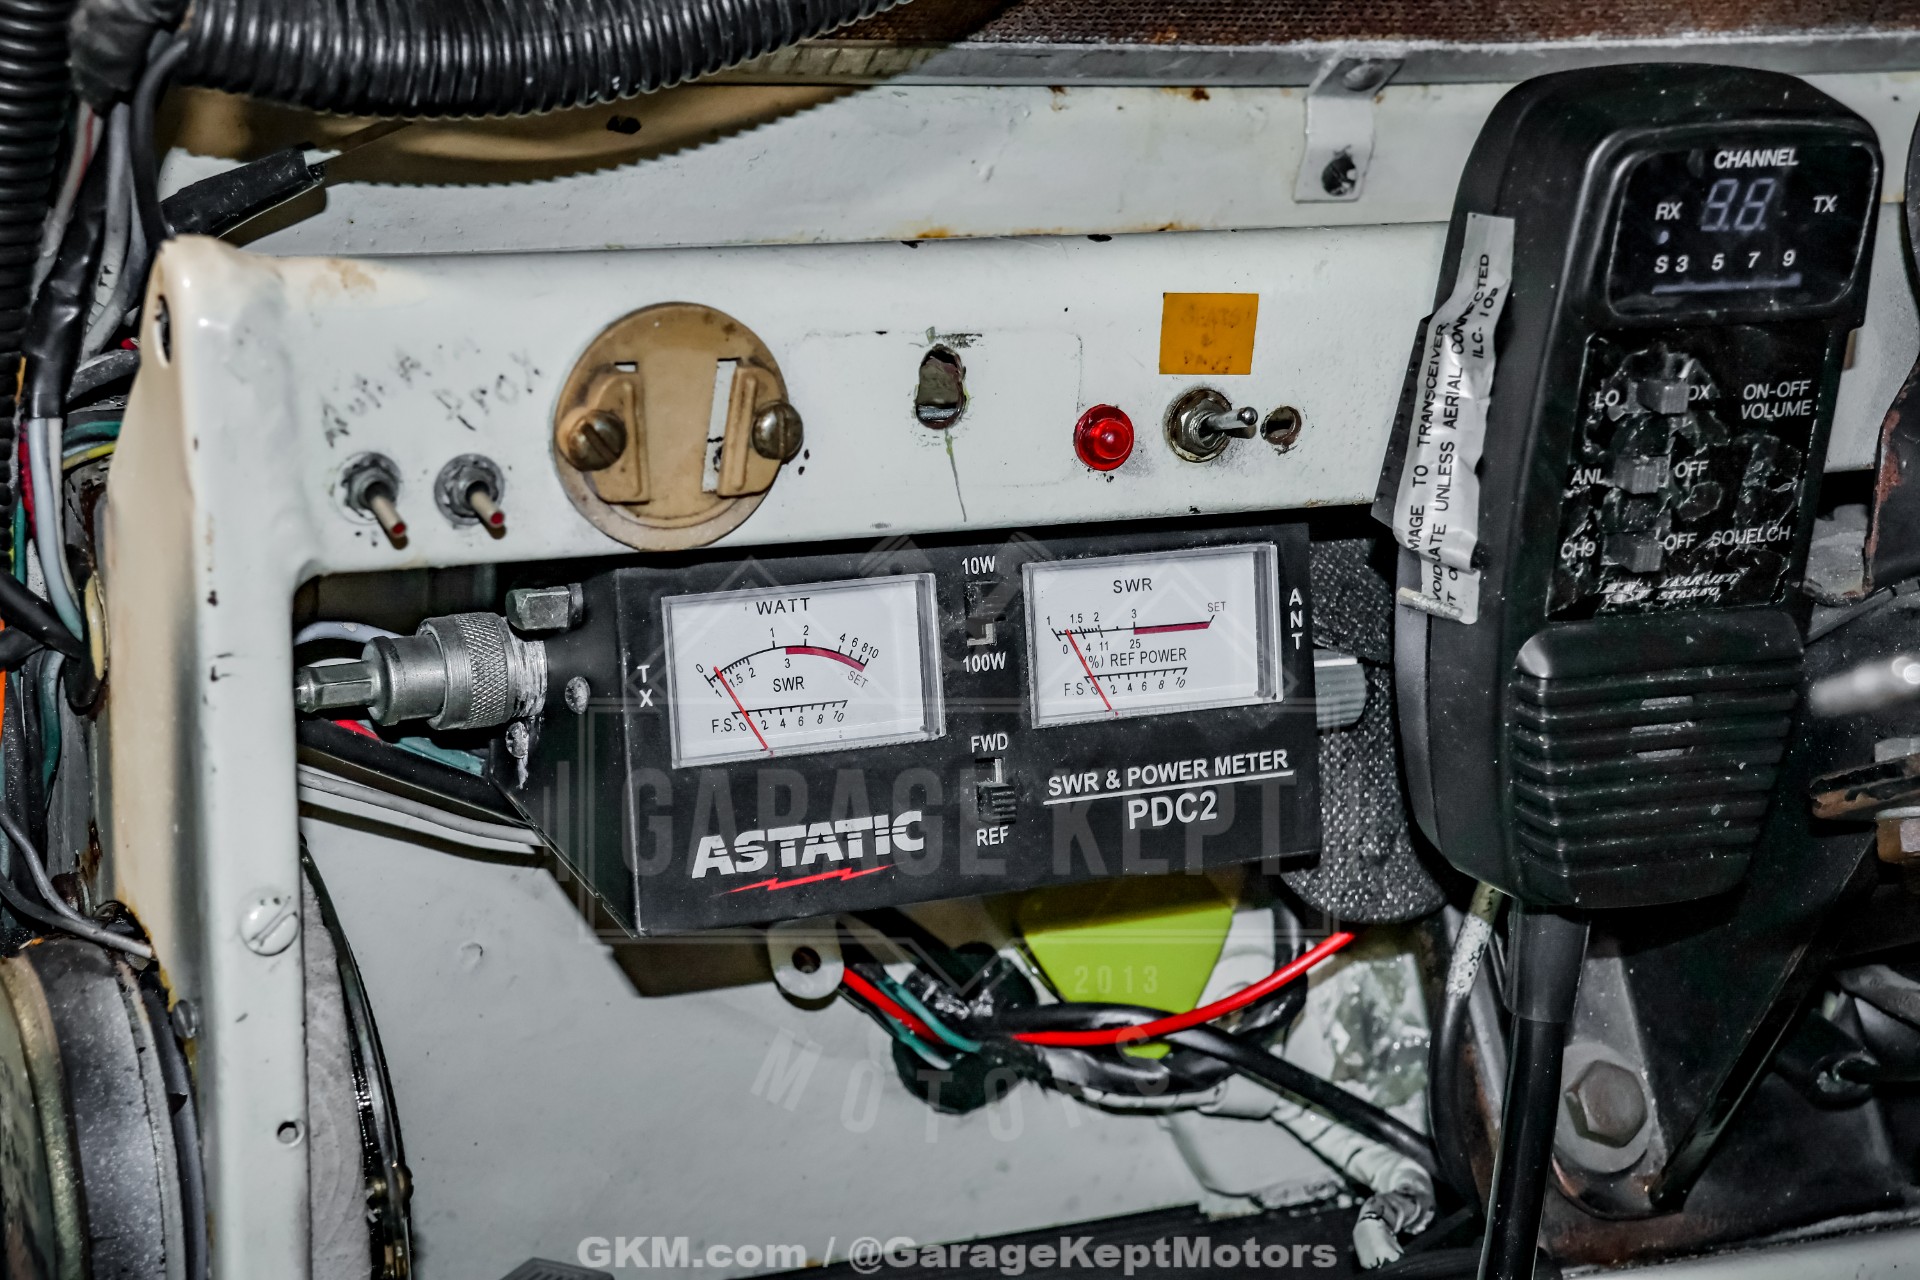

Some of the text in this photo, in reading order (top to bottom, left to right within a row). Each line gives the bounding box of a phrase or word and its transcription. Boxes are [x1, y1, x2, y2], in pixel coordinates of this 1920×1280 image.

[1714, 148, 1799, 169] CHANNEL
[1655, 202, 1683, 220] RX
[1813, 195, 1838, 213] TX
[1654, 250, 1796, 273] S 3 5 7 9
[1443, 367, 1463, 430] AERIAL
[1594, 390, 1620, 410] LO
[1743, 380, 1811, 400] ON-OFF
[1741, 400, 1812, 420] VOLUME
[1412, 465, 1428, 488] TO
[1434, 441, 1455, 511] UNLESS
[1674, 460, 1709, 478] OFF
[1711, 525, 1791, 547] SQUELCH
[1561, 541, 1596, 560] CH9
[962, 555, 995, 575] 10W
[1113, 578, 1152, 594] SWR
[756, 597, 811, 616] WATT
[1046, 601, 1227, 626] 1 1.5 2 3 SET
[695, 625, 880, 674] 0 1 2 4 6 8 10
[1062, 638, 1142, 655] 0 4 11 25
[962, 652, 1006, 674] 100W
[1110, 652, 1135, 667] REF
[1140, 648, 1187, 666] POWER
[714, 658, 869, 699] 1 1.5 2 3 SET
[773, 676, 805, 692] SWR
[1091, 686, 1099, 696] 0
[1110, 684, 1117, 695] 2
[1127, 682, 1133, 693] 4
[1141, 681, 1147, 692] 6
[1158, 680, 1165, 690] 8
[1176, 676, 1186, 689] 10
[711, 710, 845, 733] F.S. 0 2 4 6 8 10
[971, 733, 1008, 754] FWD
[1047, 749, 1288, 799] SWR & POWER METER
[1128, 791, 1218, 831] PDC2
[691, 810, 925, 880] ASTATIC
[976, 825, 1010, 848] REF
